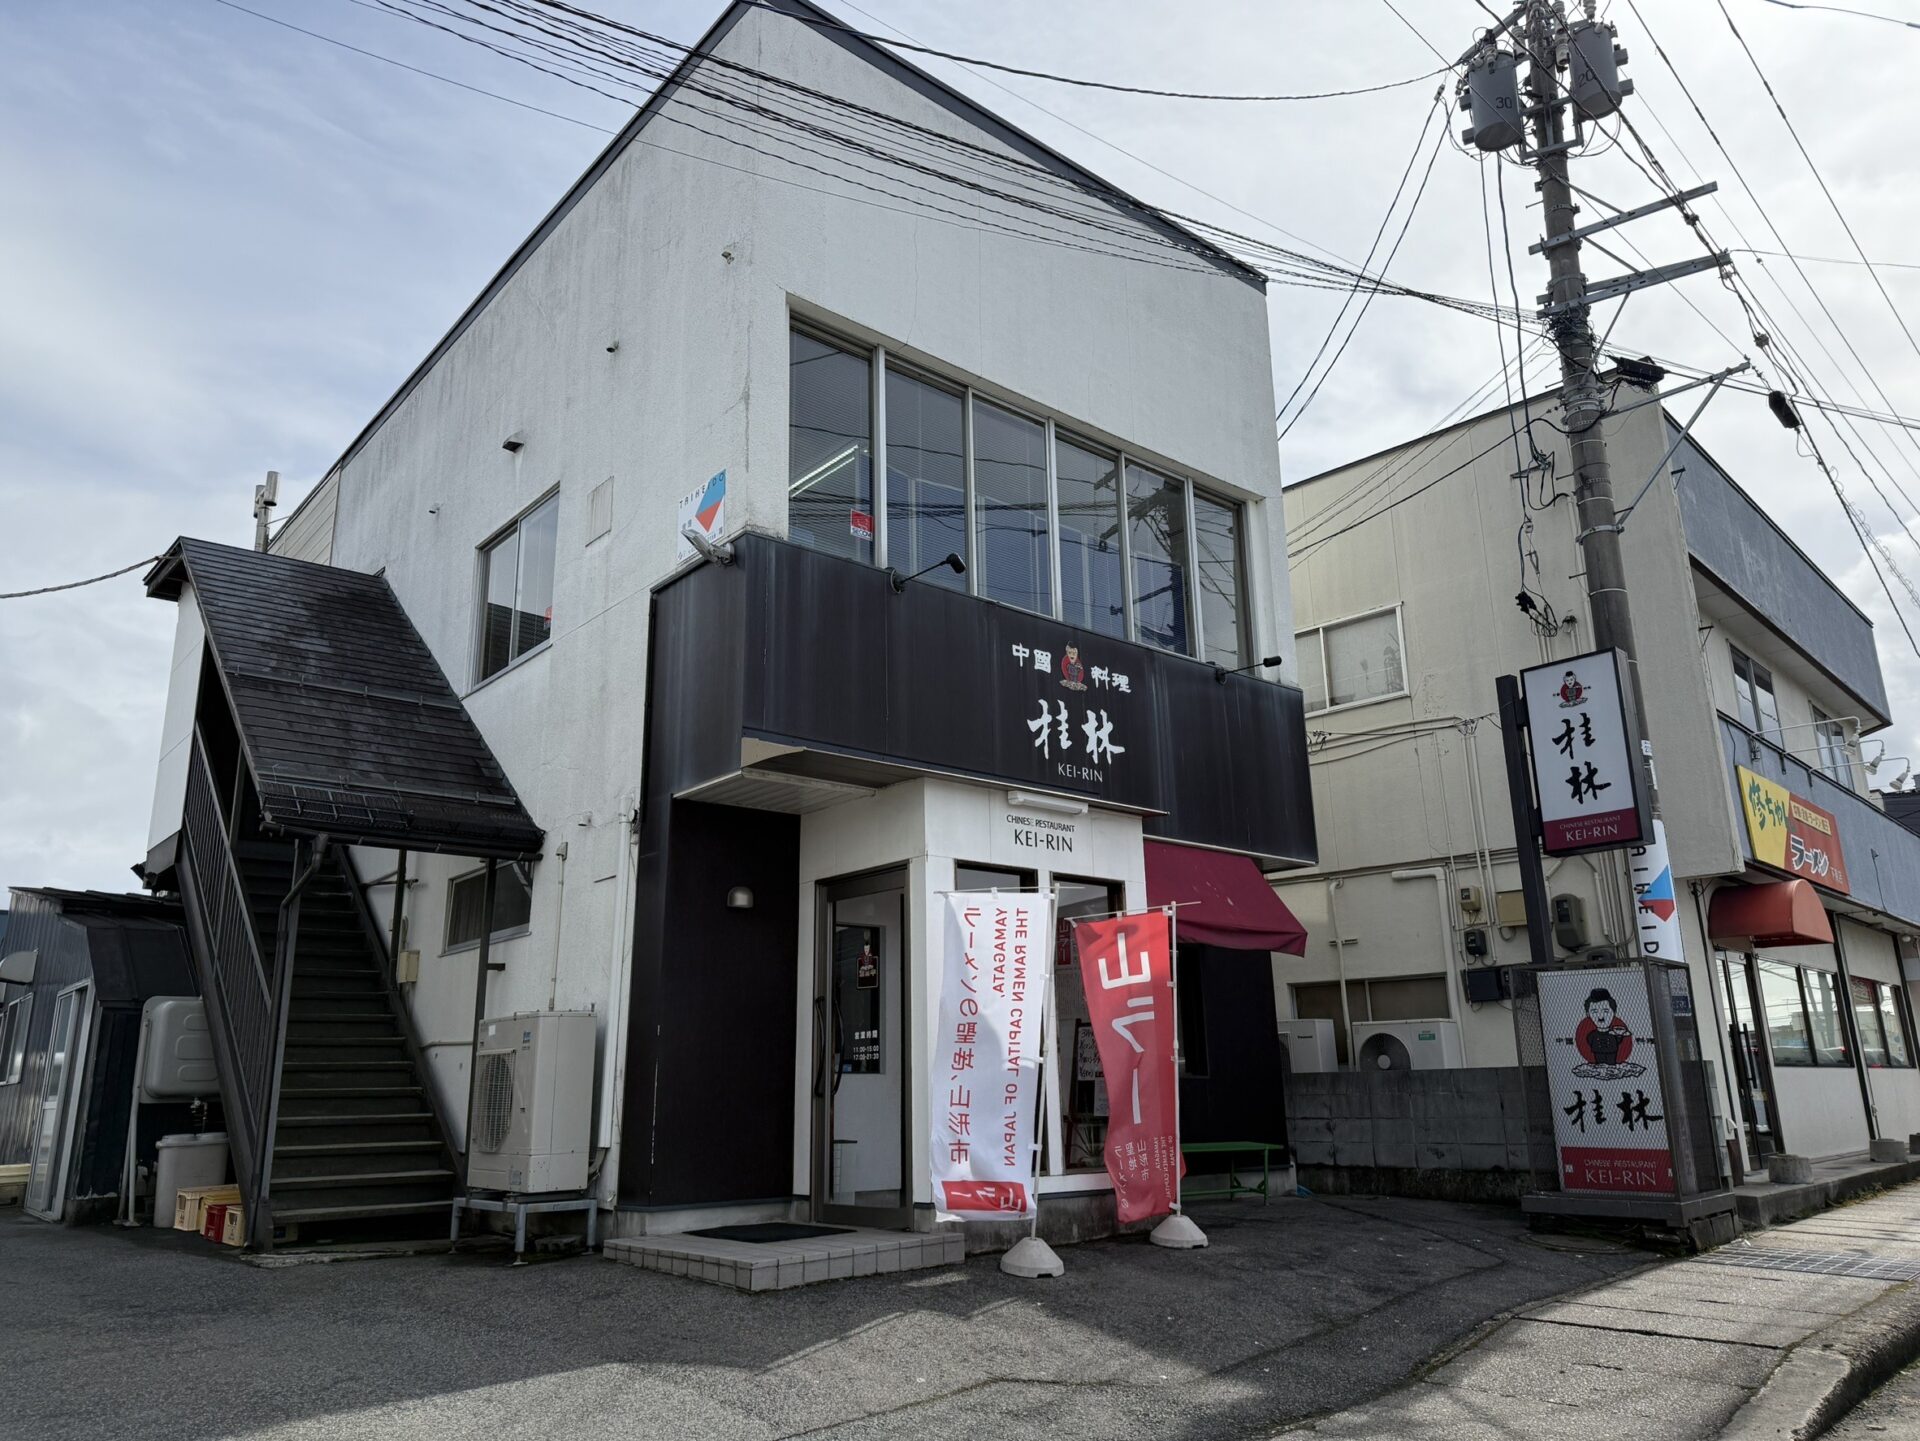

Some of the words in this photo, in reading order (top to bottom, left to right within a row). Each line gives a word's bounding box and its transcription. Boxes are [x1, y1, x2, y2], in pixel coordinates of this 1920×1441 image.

[1495, 96, 1513, 109] 30
[1090, 665, 1132, 693] 料理
[1027, 699, 1126, 765] 桂林
[1552, 712, 1612, 805] 桂林
[1058, 762, 1103, 782] KEI-RIN
[1014, 828, 1073, 853] KEI-RIN
[1566, 824, 1618, 842] KEI-RIN
[1790, 833, 1829, 877] ラーメン
[1564, 1089, 1664, 1132] 桂林
[1585, 1169, 1656, 1185] KEI-RIN
